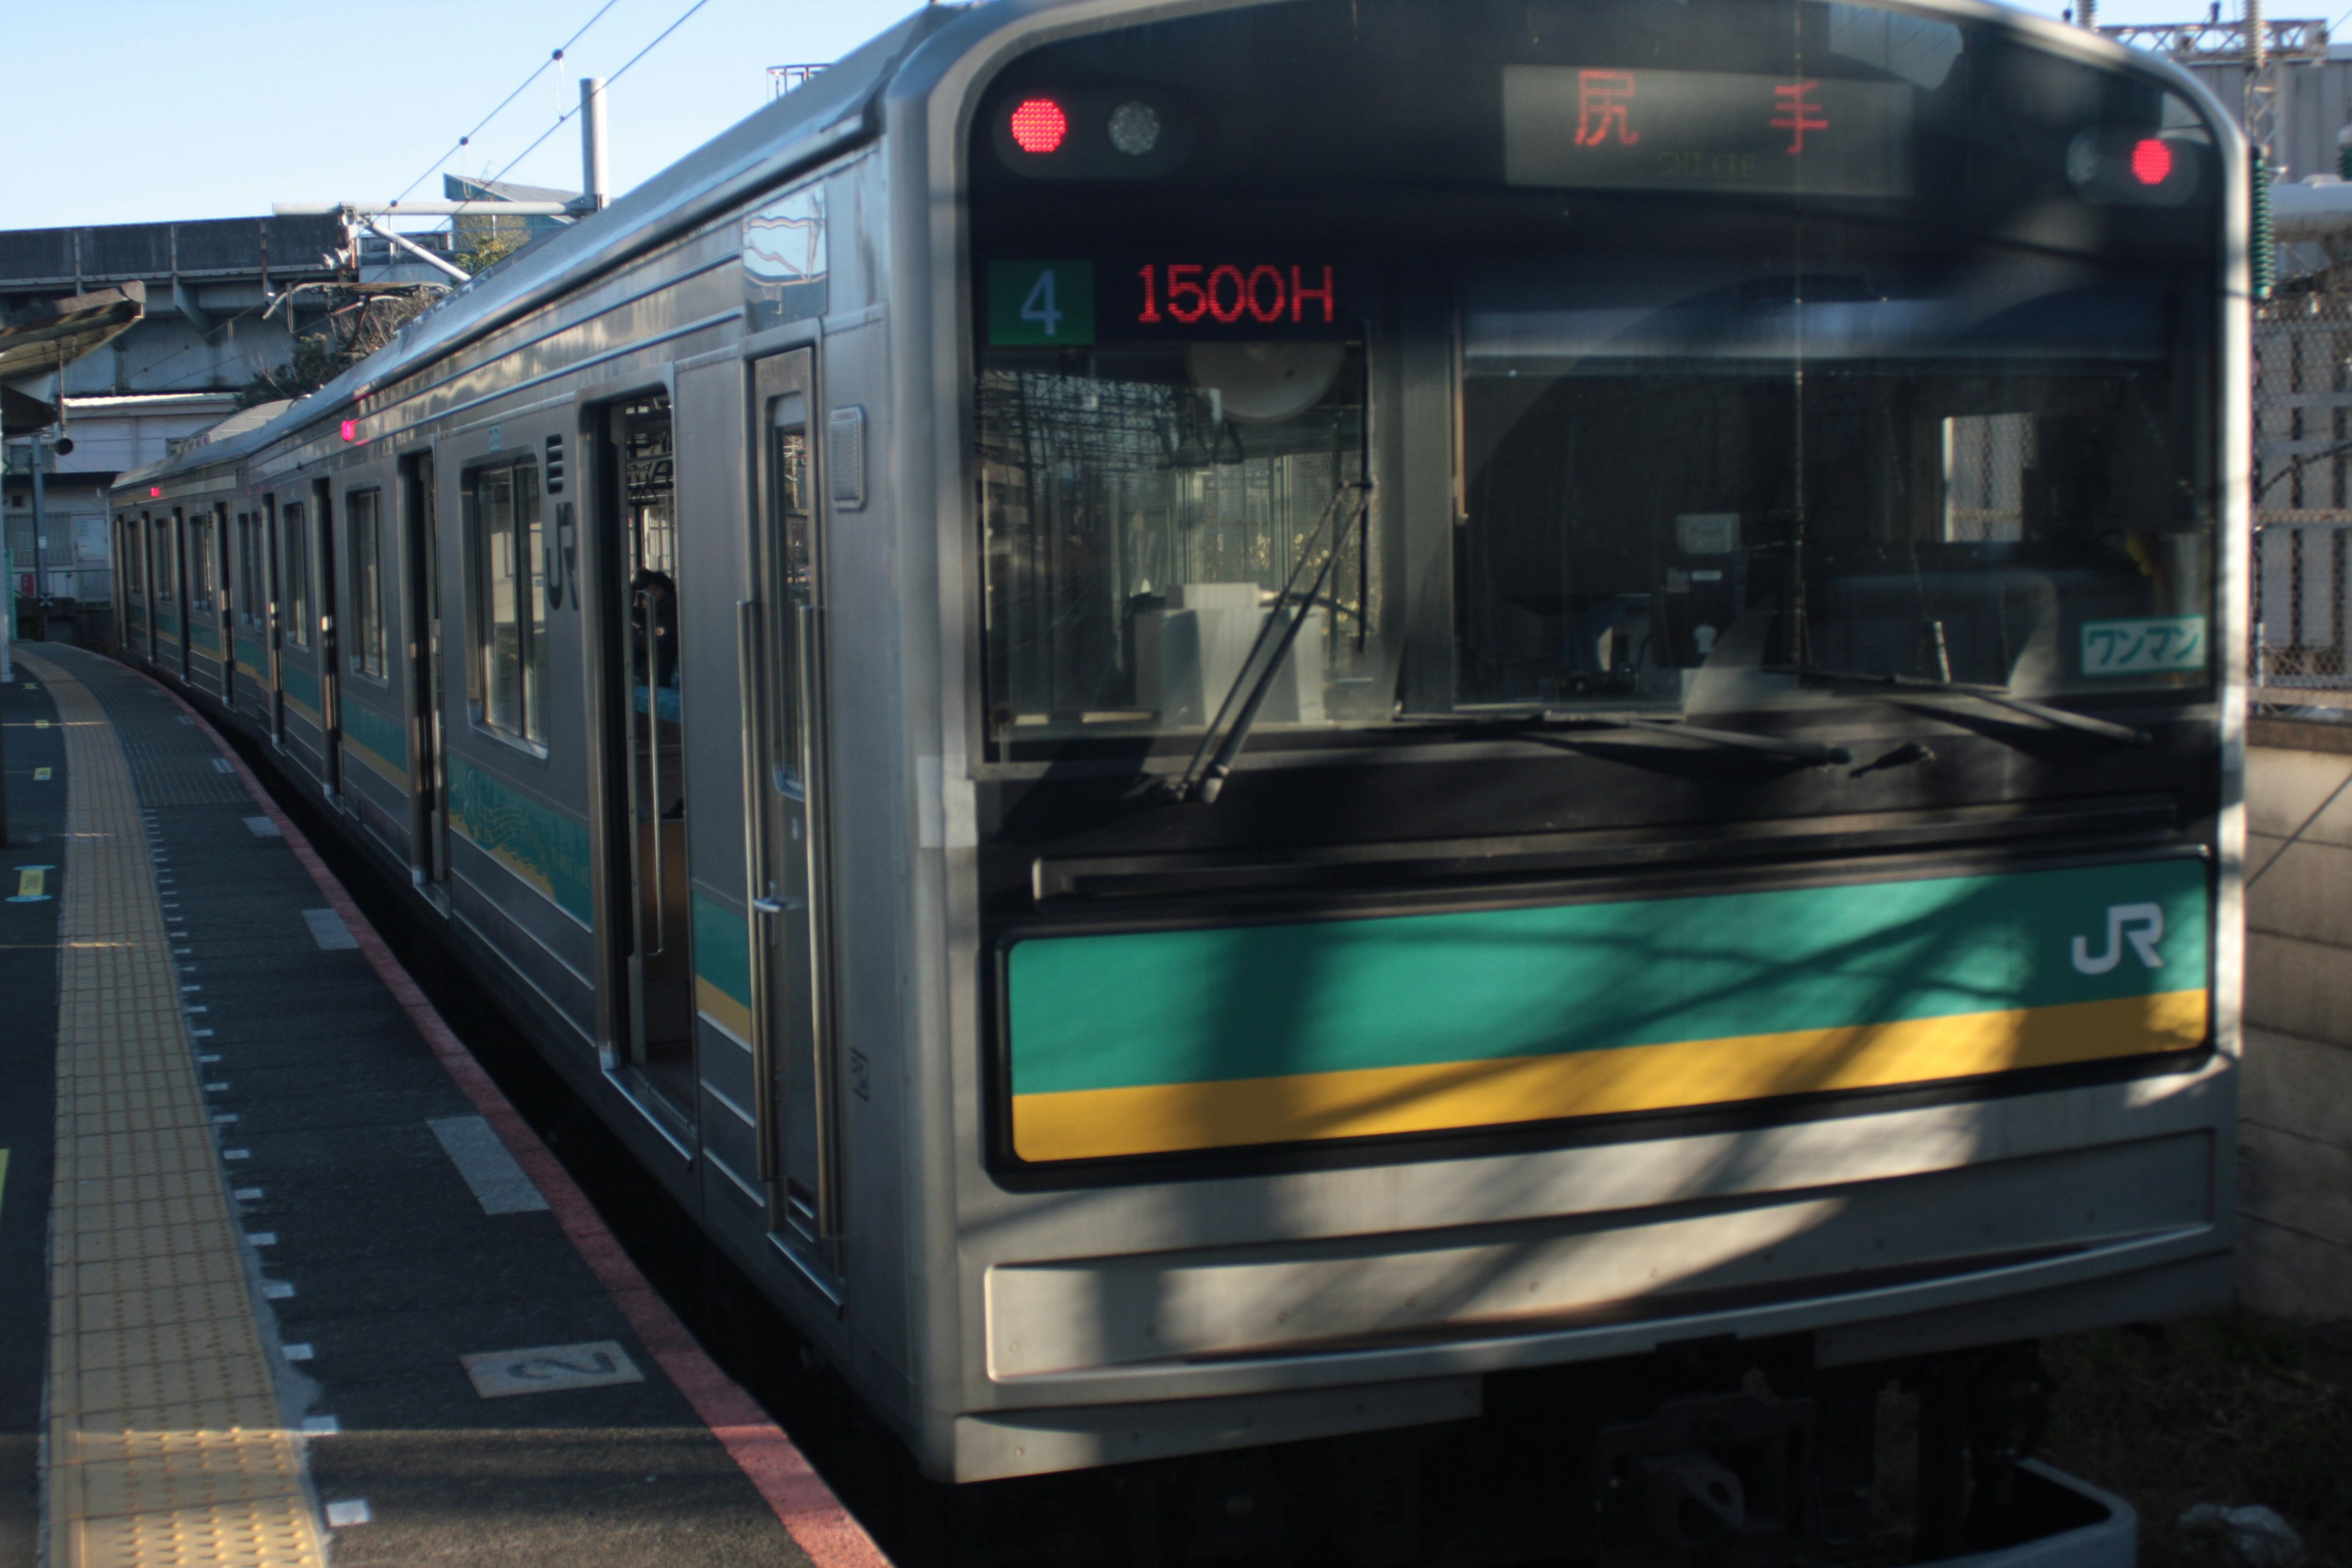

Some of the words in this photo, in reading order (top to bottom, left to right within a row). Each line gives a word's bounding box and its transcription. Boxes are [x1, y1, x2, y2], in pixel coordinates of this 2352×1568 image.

[1574, 69, 1830, 156] 尻手
[1020, 270, 1063, 336] 4
[1137, 263, 1334, 324] 1500H
[546, 501, 579, 611] JR
[2088, 625, 2200, 665] ワンマン
[2071, 902, 2165, 974] JR
[506, 1352, 617, 1380] 2
